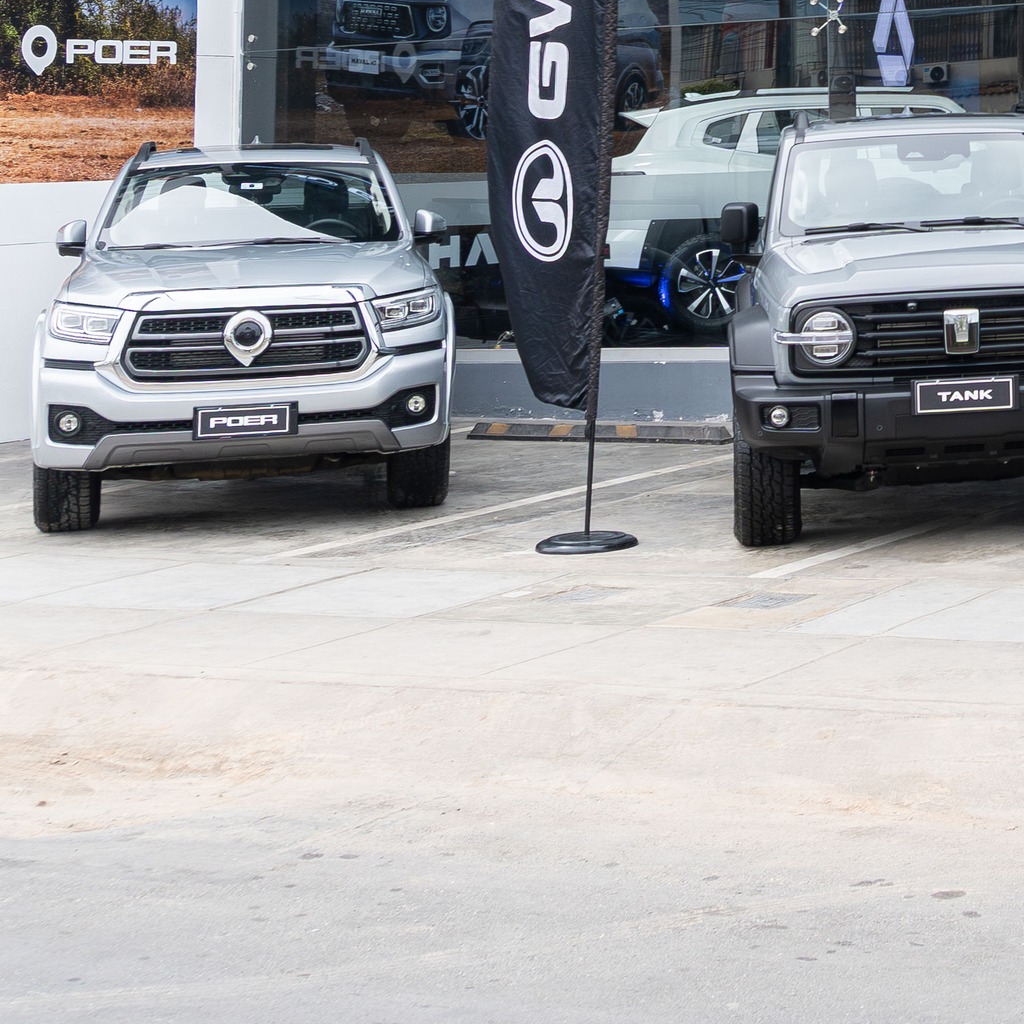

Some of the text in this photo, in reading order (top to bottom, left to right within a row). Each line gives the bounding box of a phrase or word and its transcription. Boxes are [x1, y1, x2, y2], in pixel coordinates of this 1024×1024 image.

[65, 39, 178, 65] POER
[937, 389, 993, 402] TANK
[209, 414, 278, 429] POER
